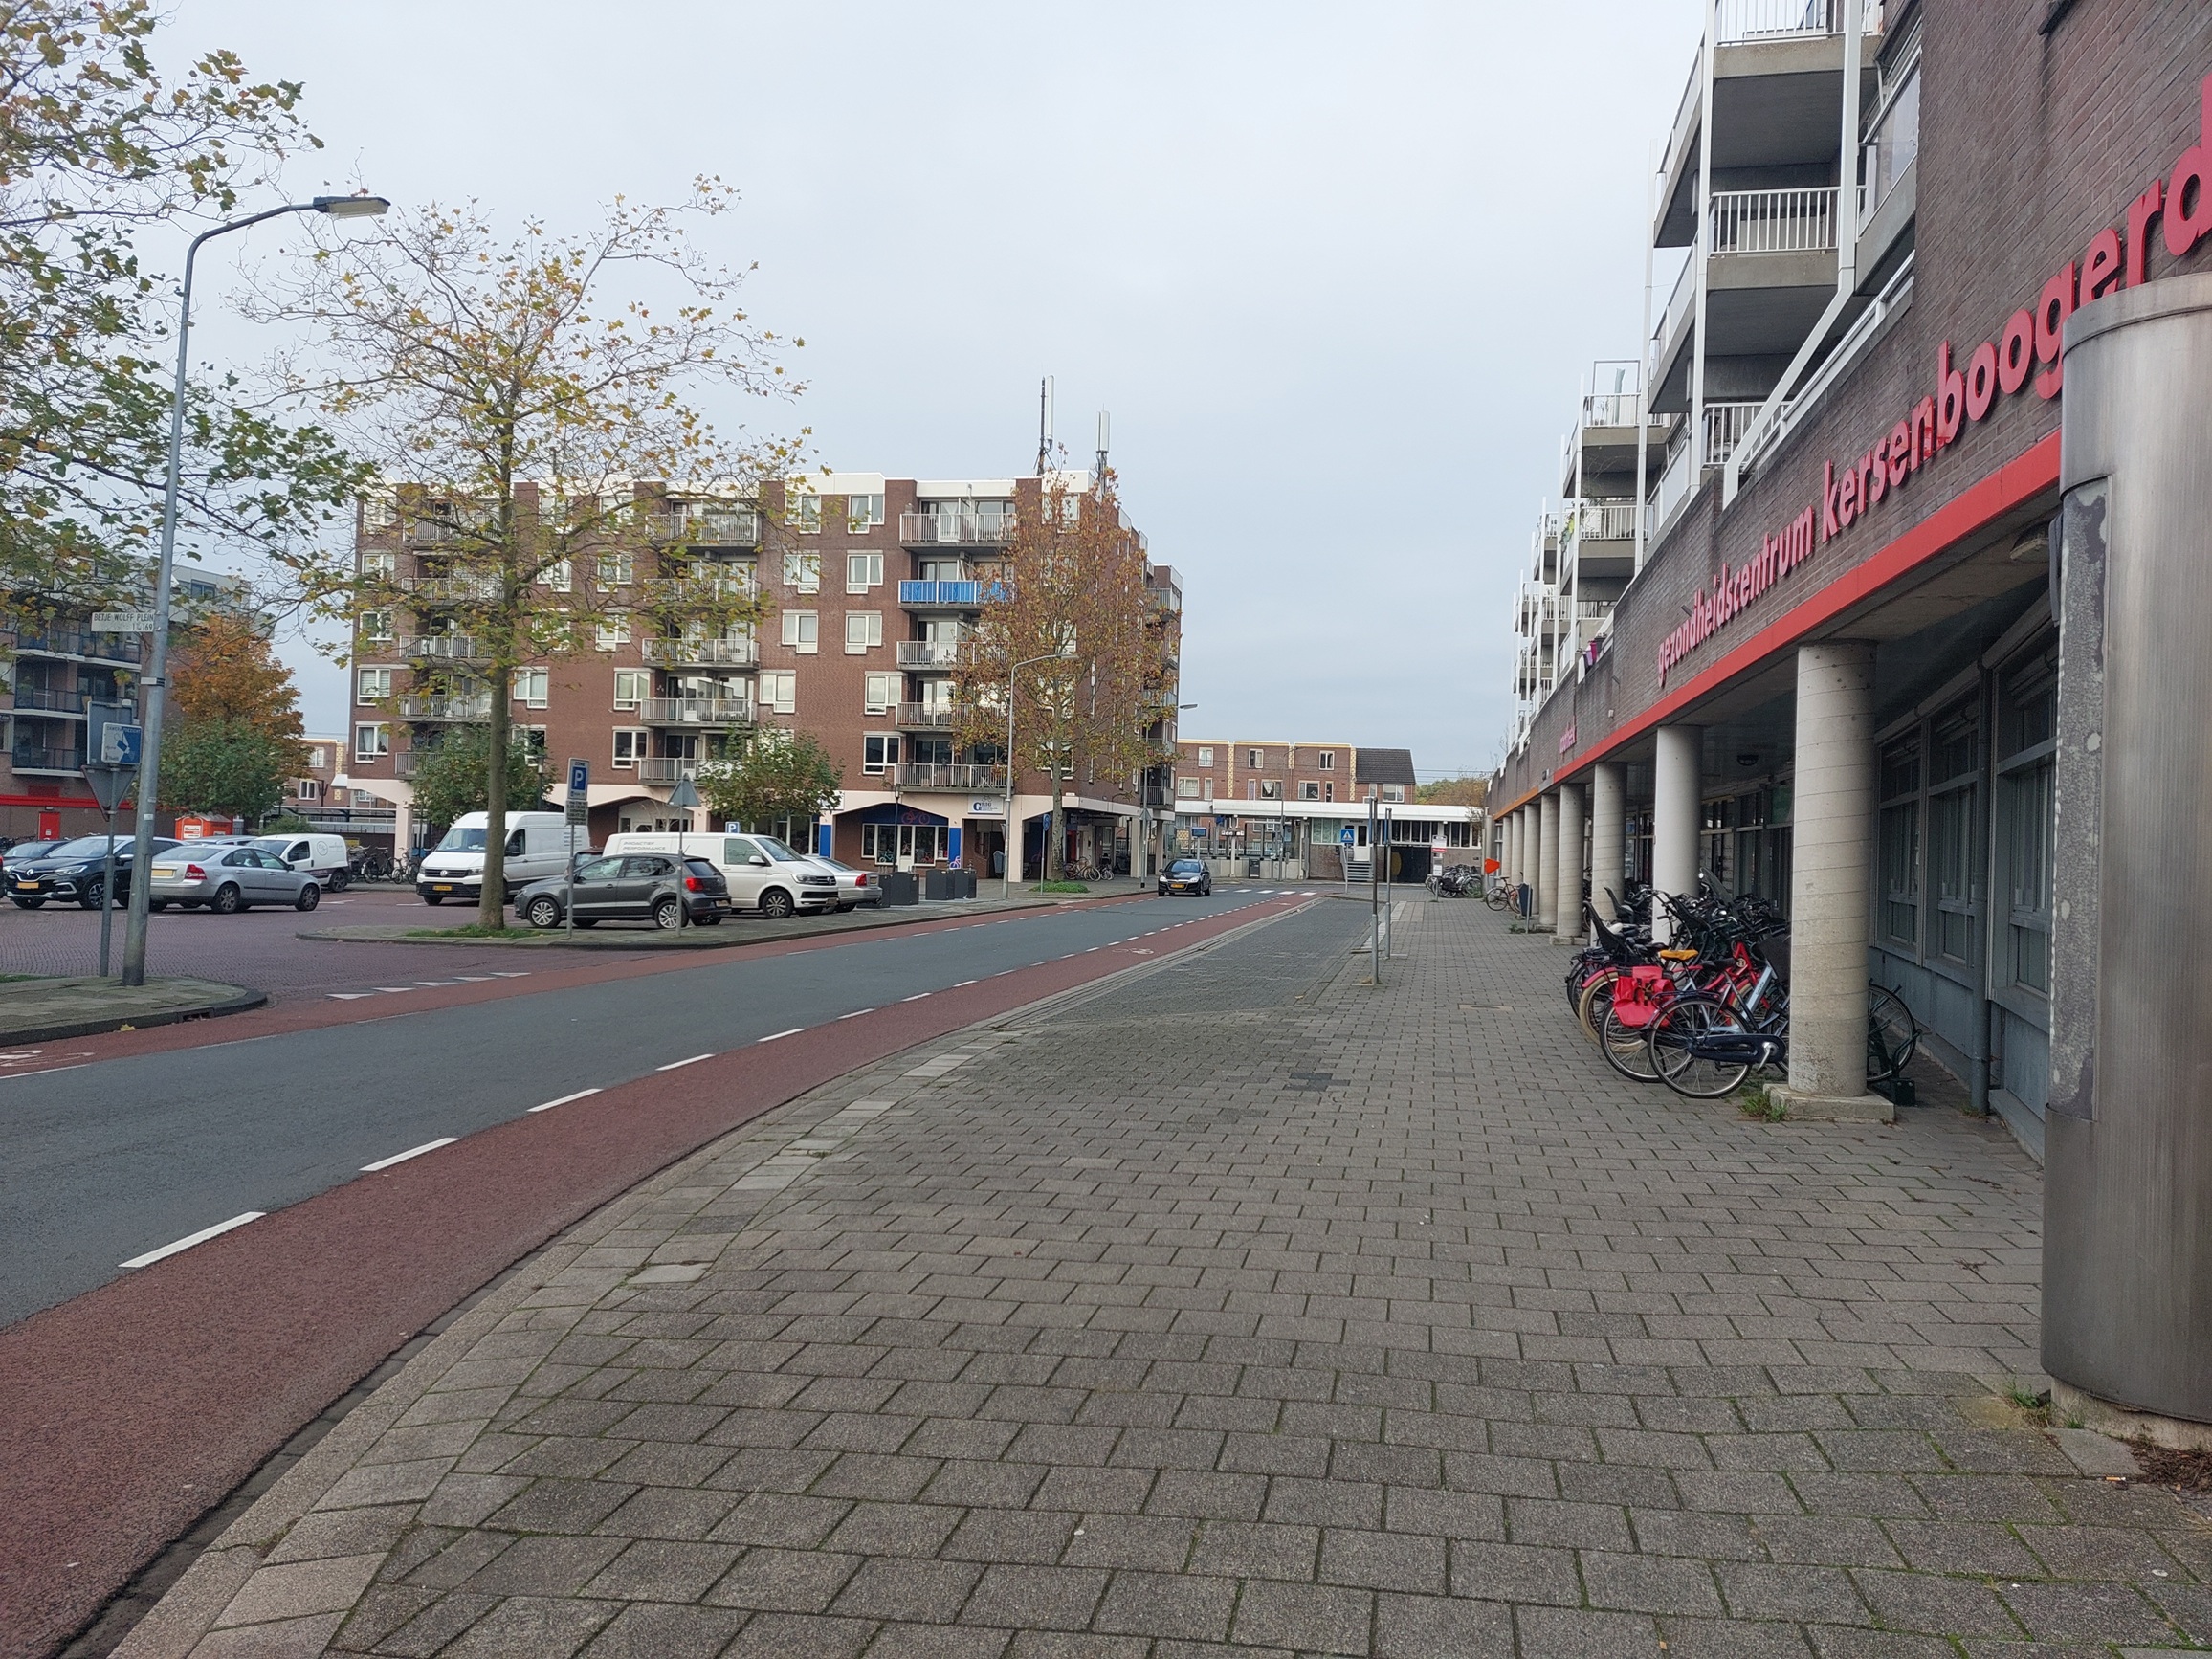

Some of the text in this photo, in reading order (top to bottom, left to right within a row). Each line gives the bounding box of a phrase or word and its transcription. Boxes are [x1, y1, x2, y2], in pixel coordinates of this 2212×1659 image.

[1658, 73, 2212, 688] gezondheidscentrum kersenboogerd
[94, 613, 154, 623] BETJE WOLFF PLEIN
[574, 769, 585, 787] P
